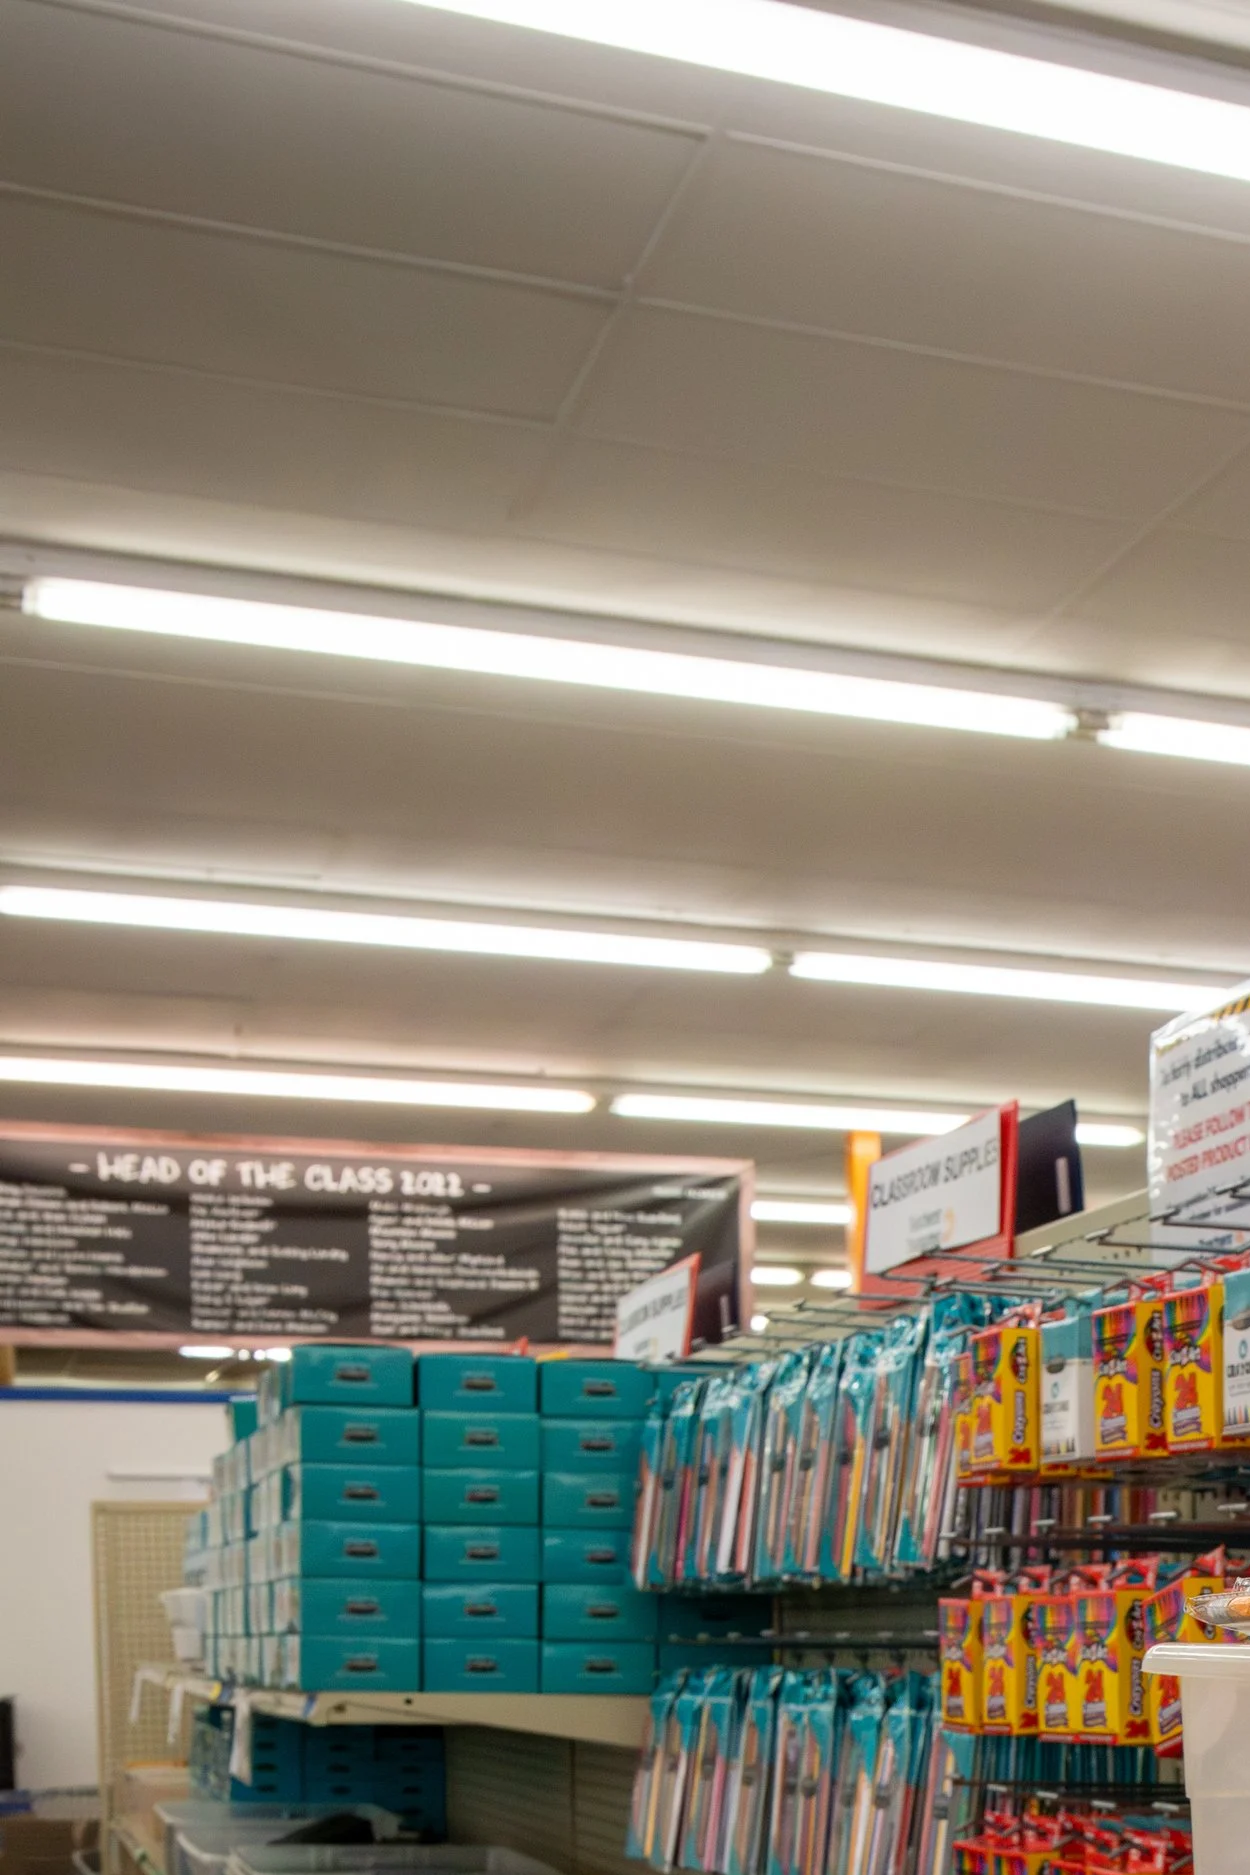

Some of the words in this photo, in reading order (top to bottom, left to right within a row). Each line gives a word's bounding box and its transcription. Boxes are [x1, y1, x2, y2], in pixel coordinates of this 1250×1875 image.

[1190, 1081, 1208, 1103] ALL
[1205, 1105, 1247, 1137] FOLLOW
[97, 1152, 181, 1184] HEAD
[188, 1159, 227, 1186] OF
[237, 1161, 297, 1190] THE
[304, 1164, 393, 1194] CLASS
[400, 1170, 464, 1197] 2022
[1166, 1156, 1200, 1185] POSTED
[1201, 1136, 1249, 1169] PRODUCT
[871, 1160, 942, 1209] CLASSROOM
